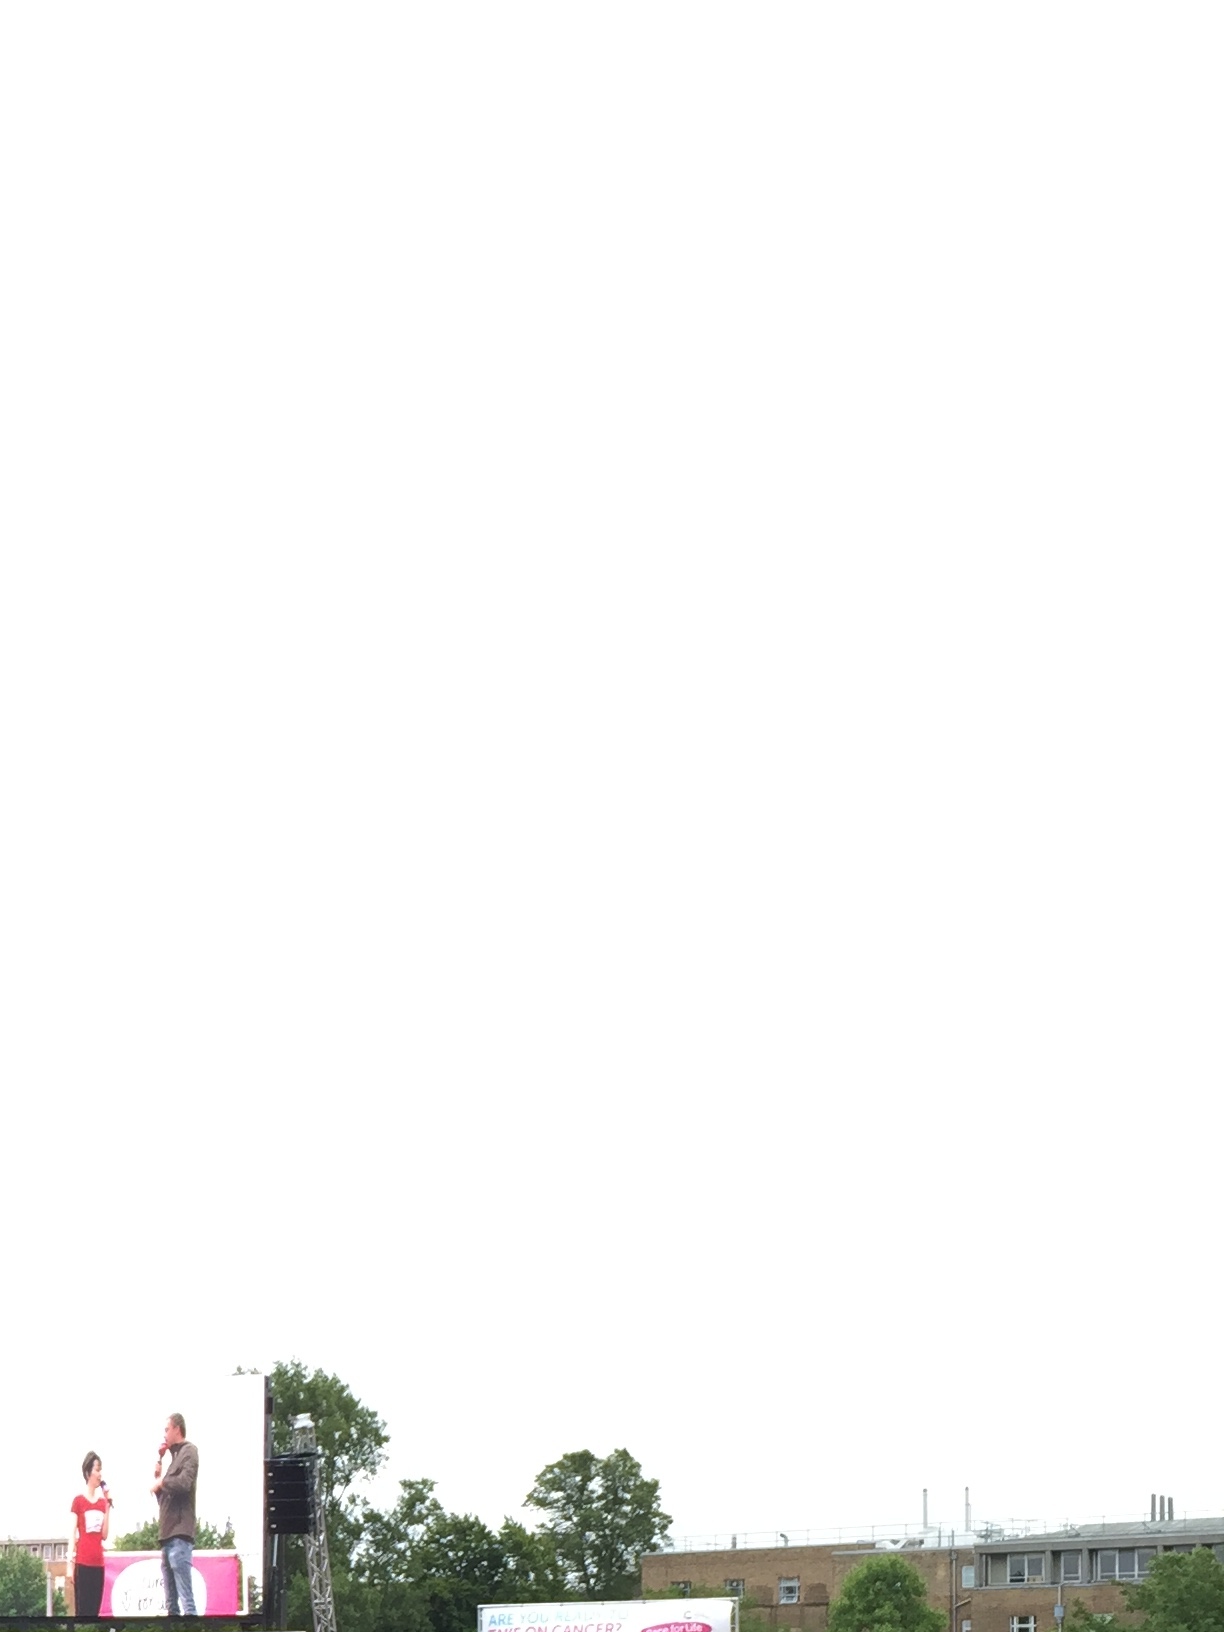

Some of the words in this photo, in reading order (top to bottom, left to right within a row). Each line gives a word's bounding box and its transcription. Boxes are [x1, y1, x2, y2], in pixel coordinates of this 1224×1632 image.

[488, 1613, 514, 1626] ARE
[520, 1611, 549, 1624] YOU
[685, 1623, 703, 1632] Life
